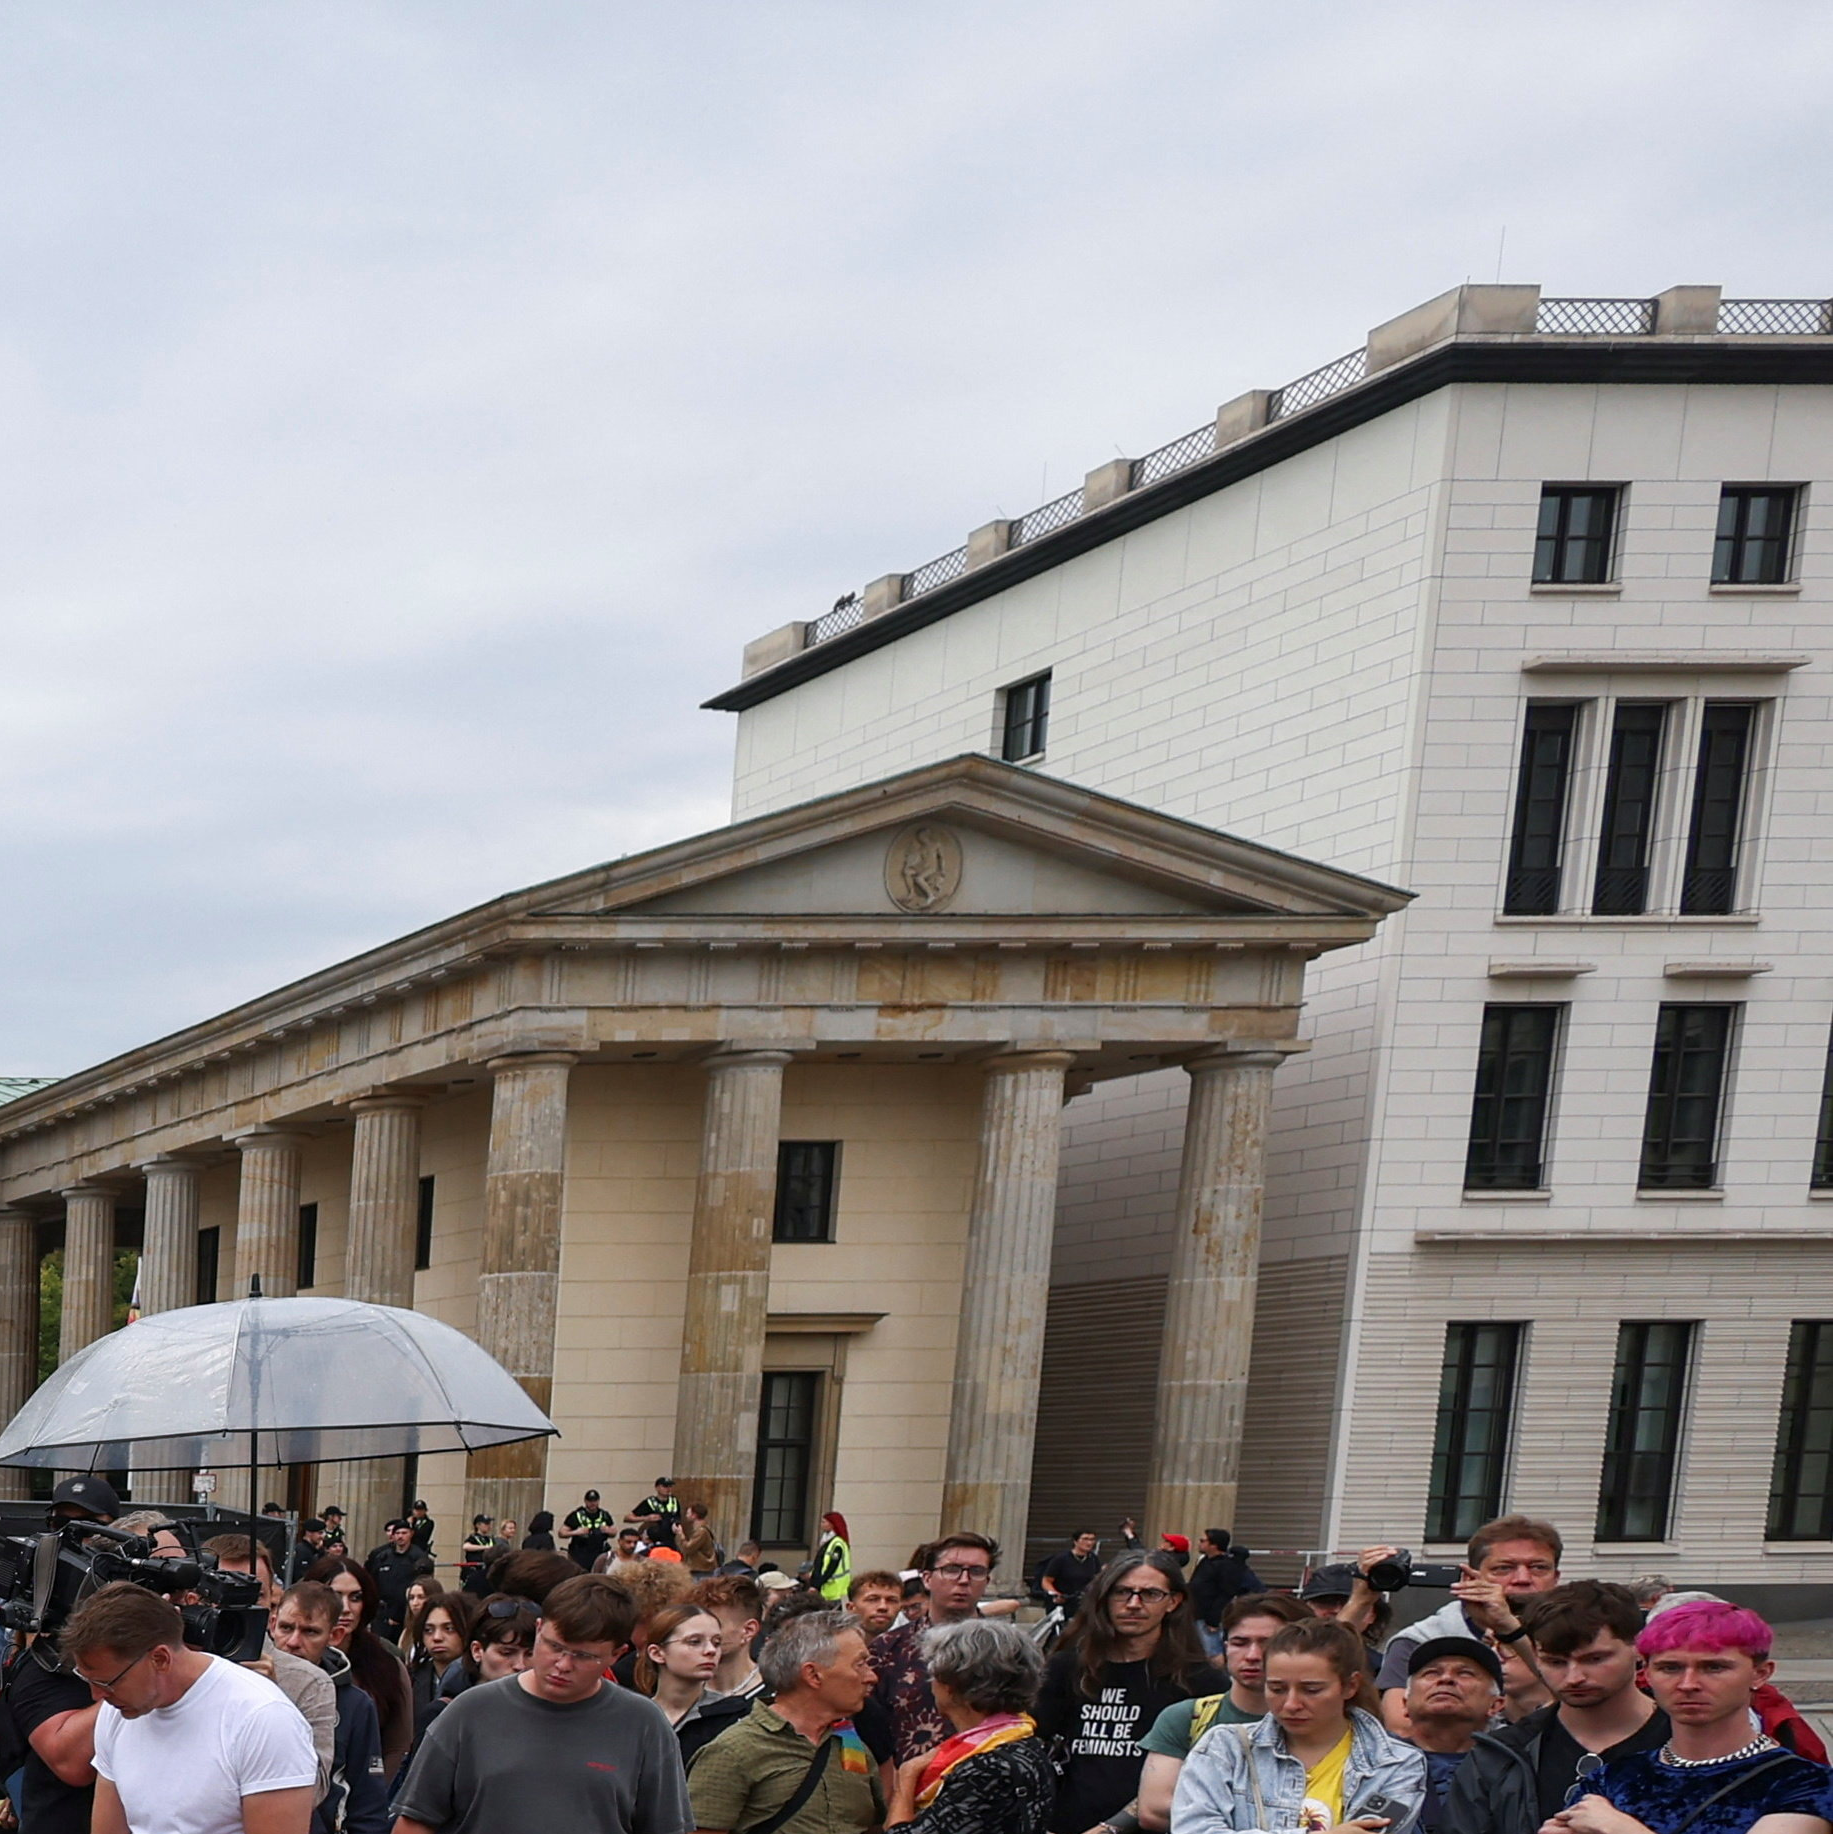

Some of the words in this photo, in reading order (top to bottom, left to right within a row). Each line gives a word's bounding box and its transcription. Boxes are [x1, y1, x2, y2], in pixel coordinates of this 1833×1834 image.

[1100, 1688, 1127, 1704] WE
[1080, 1704, 1140, 1722] SHOULD
[1082, 1721, 1109, 1739] ALL
[1112, 1722, 1133, 1740] BE
[1071, 1739, 1143, 1758] FEMINISTS
